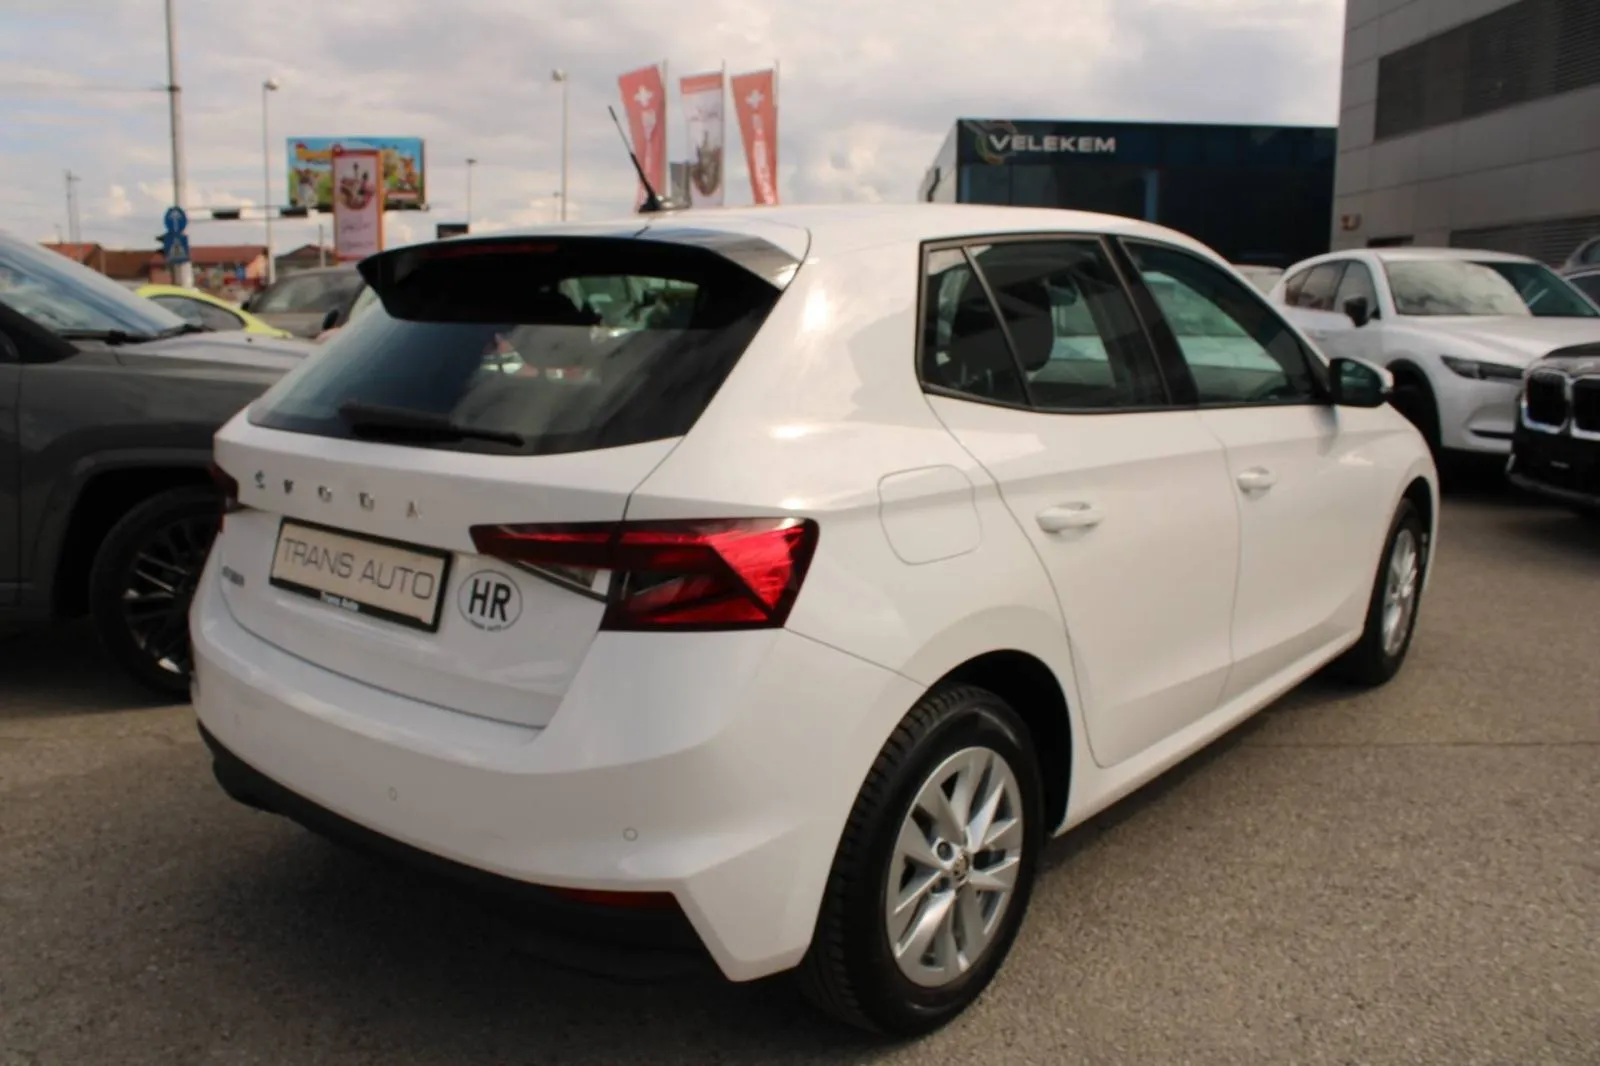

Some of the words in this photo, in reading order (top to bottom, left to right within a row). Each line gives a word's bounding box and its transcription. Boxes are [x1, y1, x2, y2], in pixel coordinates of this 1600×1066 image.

[989, 134, 1116, 152] VELEKEM
[283, 538, 354, 579] TRANS
[359, 560, 435, 600] AUTO
[468, 578, 511, 622] HR
